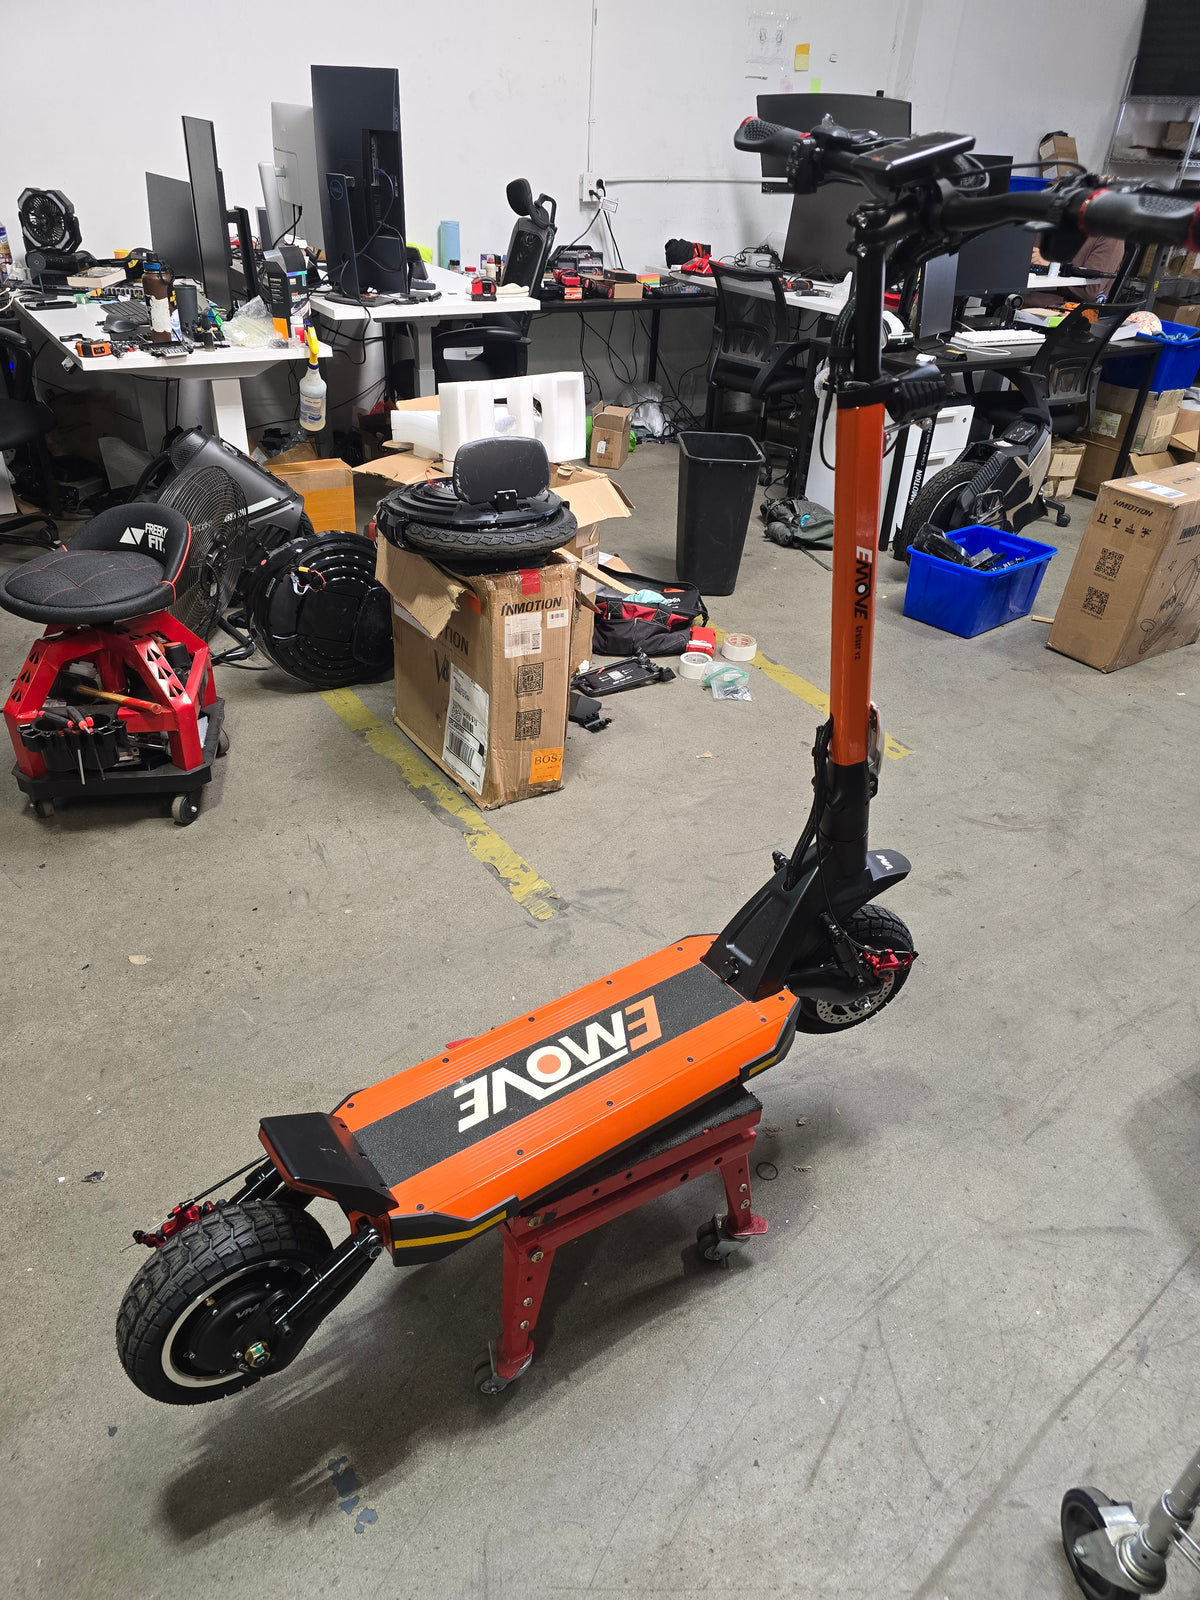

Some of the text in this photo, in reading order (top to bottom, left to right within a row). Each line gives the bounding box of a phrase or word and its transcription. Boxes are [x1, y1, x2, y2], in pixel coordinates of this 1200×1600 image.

[144, 522, 169, 538] FREEKY
[854, 545, 873, 620] EMOVE
[501, 597, 562, 617] INMOTION
[453, 994, 663, 1133] EMOVE
